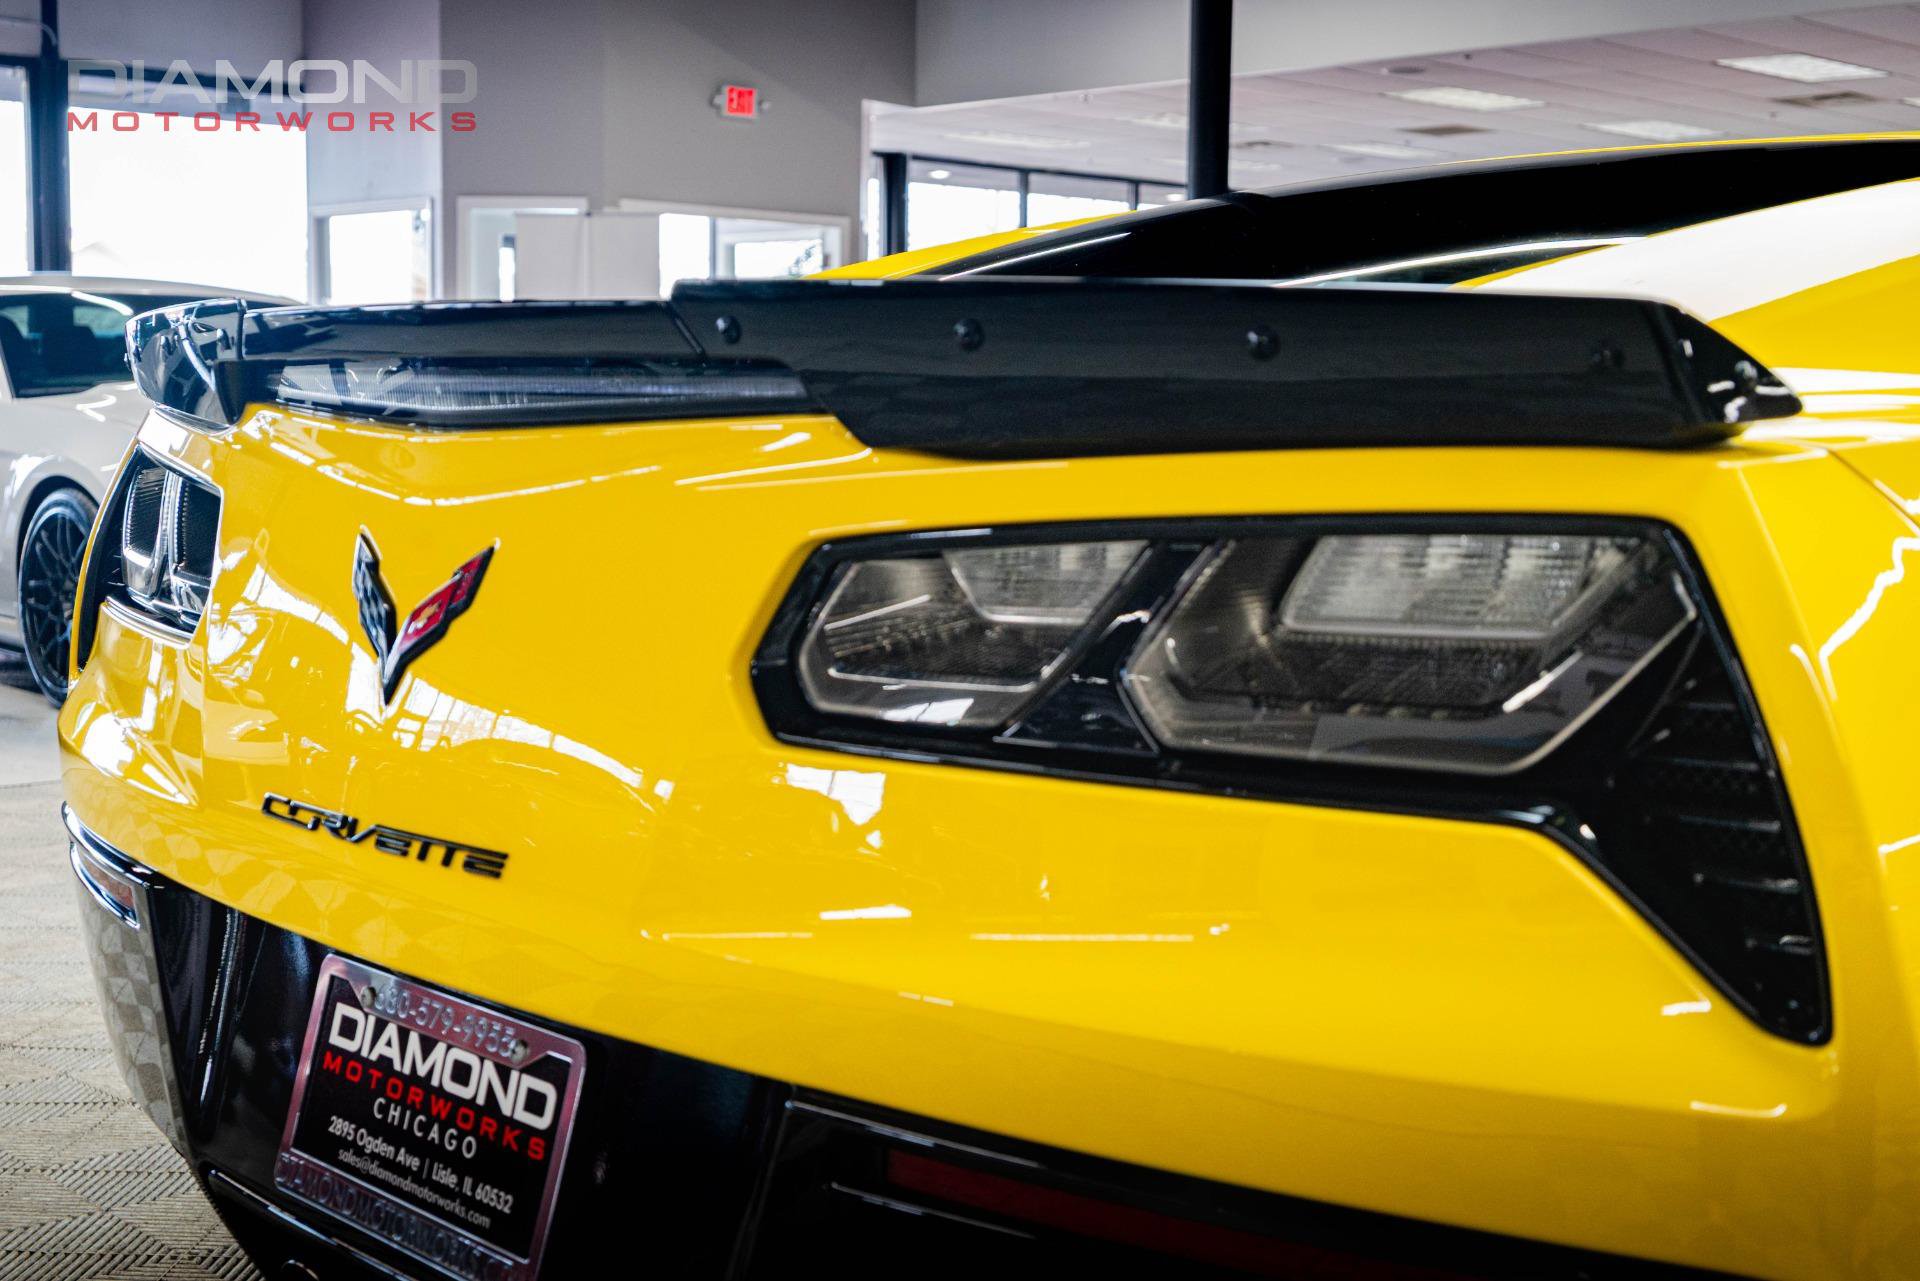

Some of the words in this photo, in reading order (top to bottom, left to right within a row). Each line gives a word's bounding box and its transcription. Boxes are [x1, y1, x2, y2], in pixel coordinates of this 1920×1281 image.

[261, 791, 509, 879] CORVETTE
[322, 1051, 546, 1161] MOTORWORKS
[328, 1002, 558, 1131] DIAMOND
[328, 1115, 356, 1141] 2895
[356, 1128, 395, 1160] Ogden
[395, 1148, 420, 1171] Ave
[431, 1161, 459, 1192] Lisle,
[462, 1176, 473, 1197] IL
[474, 1183, 514, 1215] 60532
[373, 1097, 477, 1159] CHICAGO
[337, 1148, 491, 1229] sales@diamondmotorworks.com
